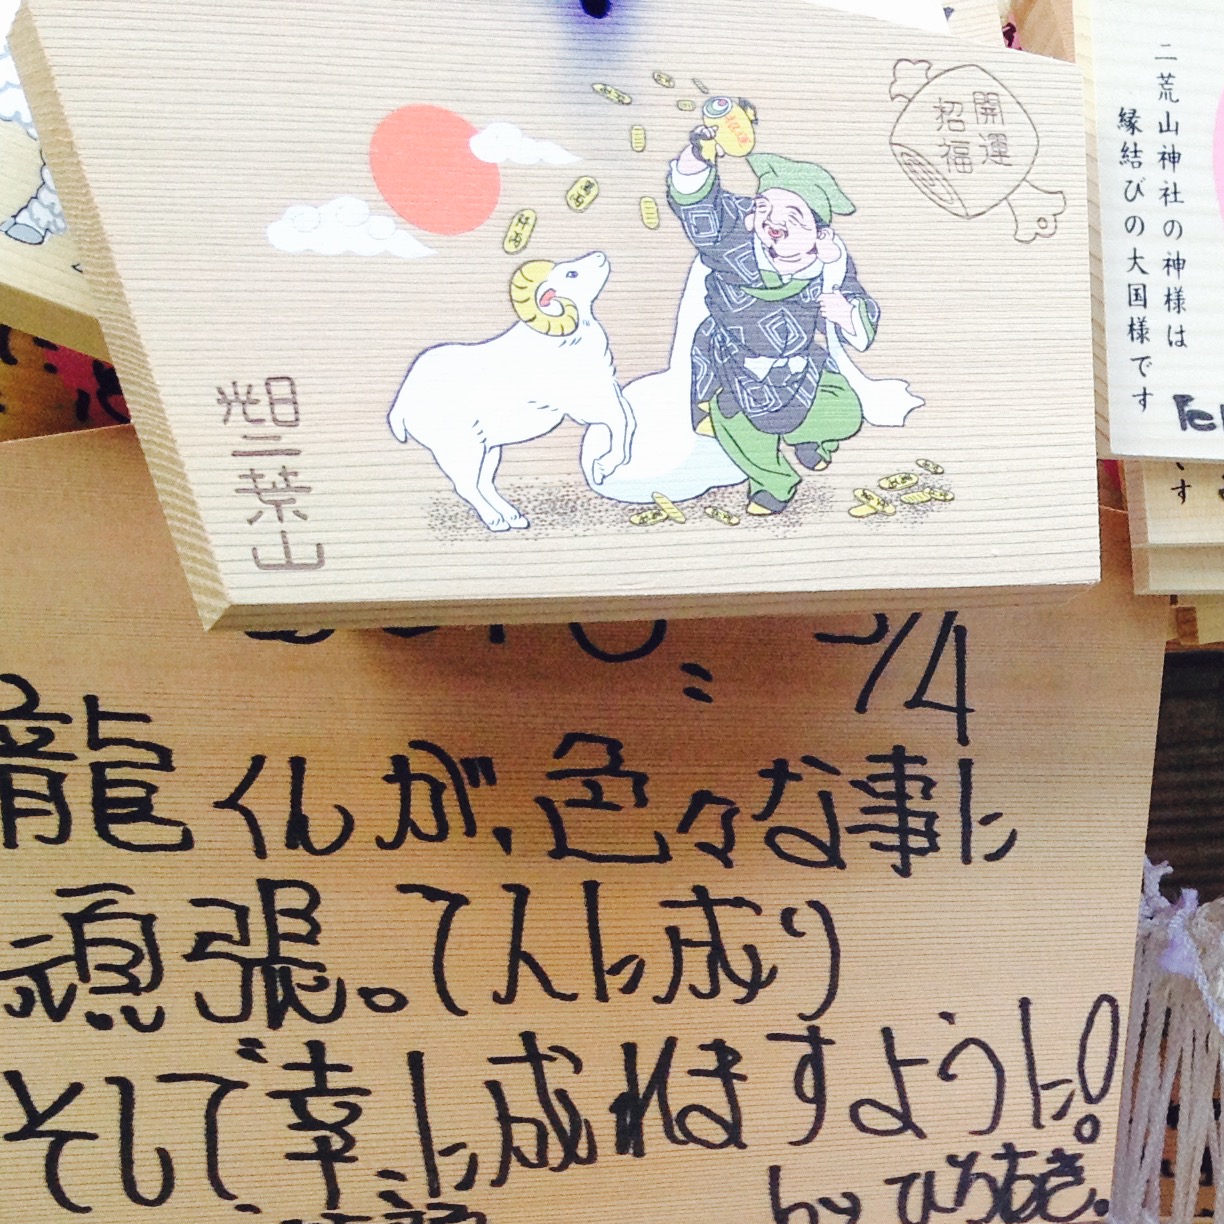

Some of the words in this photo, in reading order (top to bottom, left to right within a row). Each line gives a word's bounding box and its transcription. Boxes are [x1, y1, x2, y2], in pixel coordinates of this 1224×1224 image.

[932, 97, 974, 175] 招福
[971, 90, 1013, 168] 開運
[1153, 42, 1189, 350] 二荒山神社の神様は
[1117, 108, 1152, 412] 縁結びの大国様です
